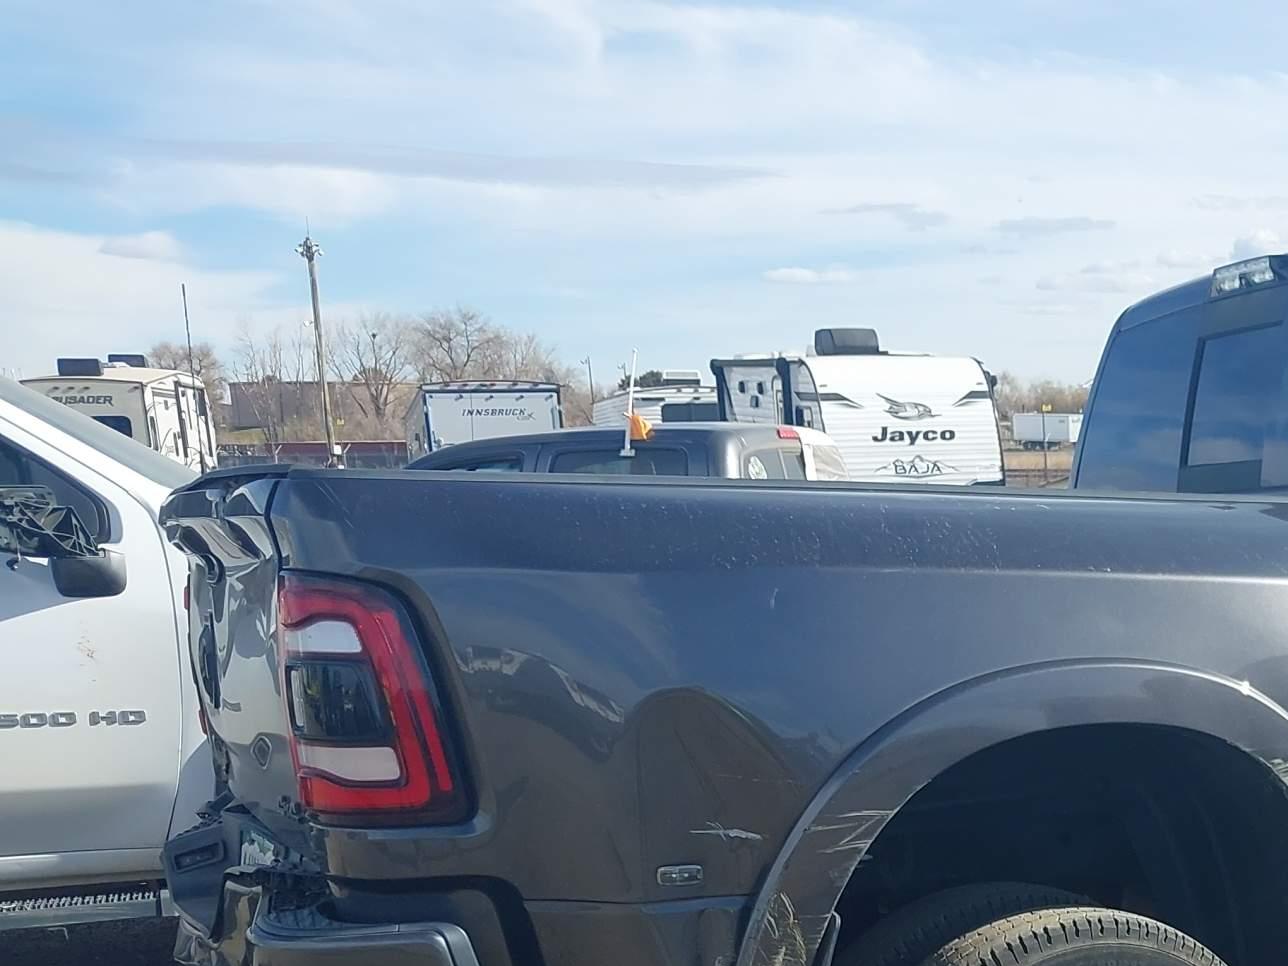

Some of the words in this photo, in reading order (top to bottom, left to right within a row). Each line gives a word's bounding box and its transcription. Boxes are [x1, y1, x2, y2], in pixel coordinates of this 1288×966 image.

[461, 407, 526, 417] INNSBRUCK
[872, 426, 956, 446] Jayco
[894, 463, 943, 475] BAJA
[88, 710, 147, 727] HD
